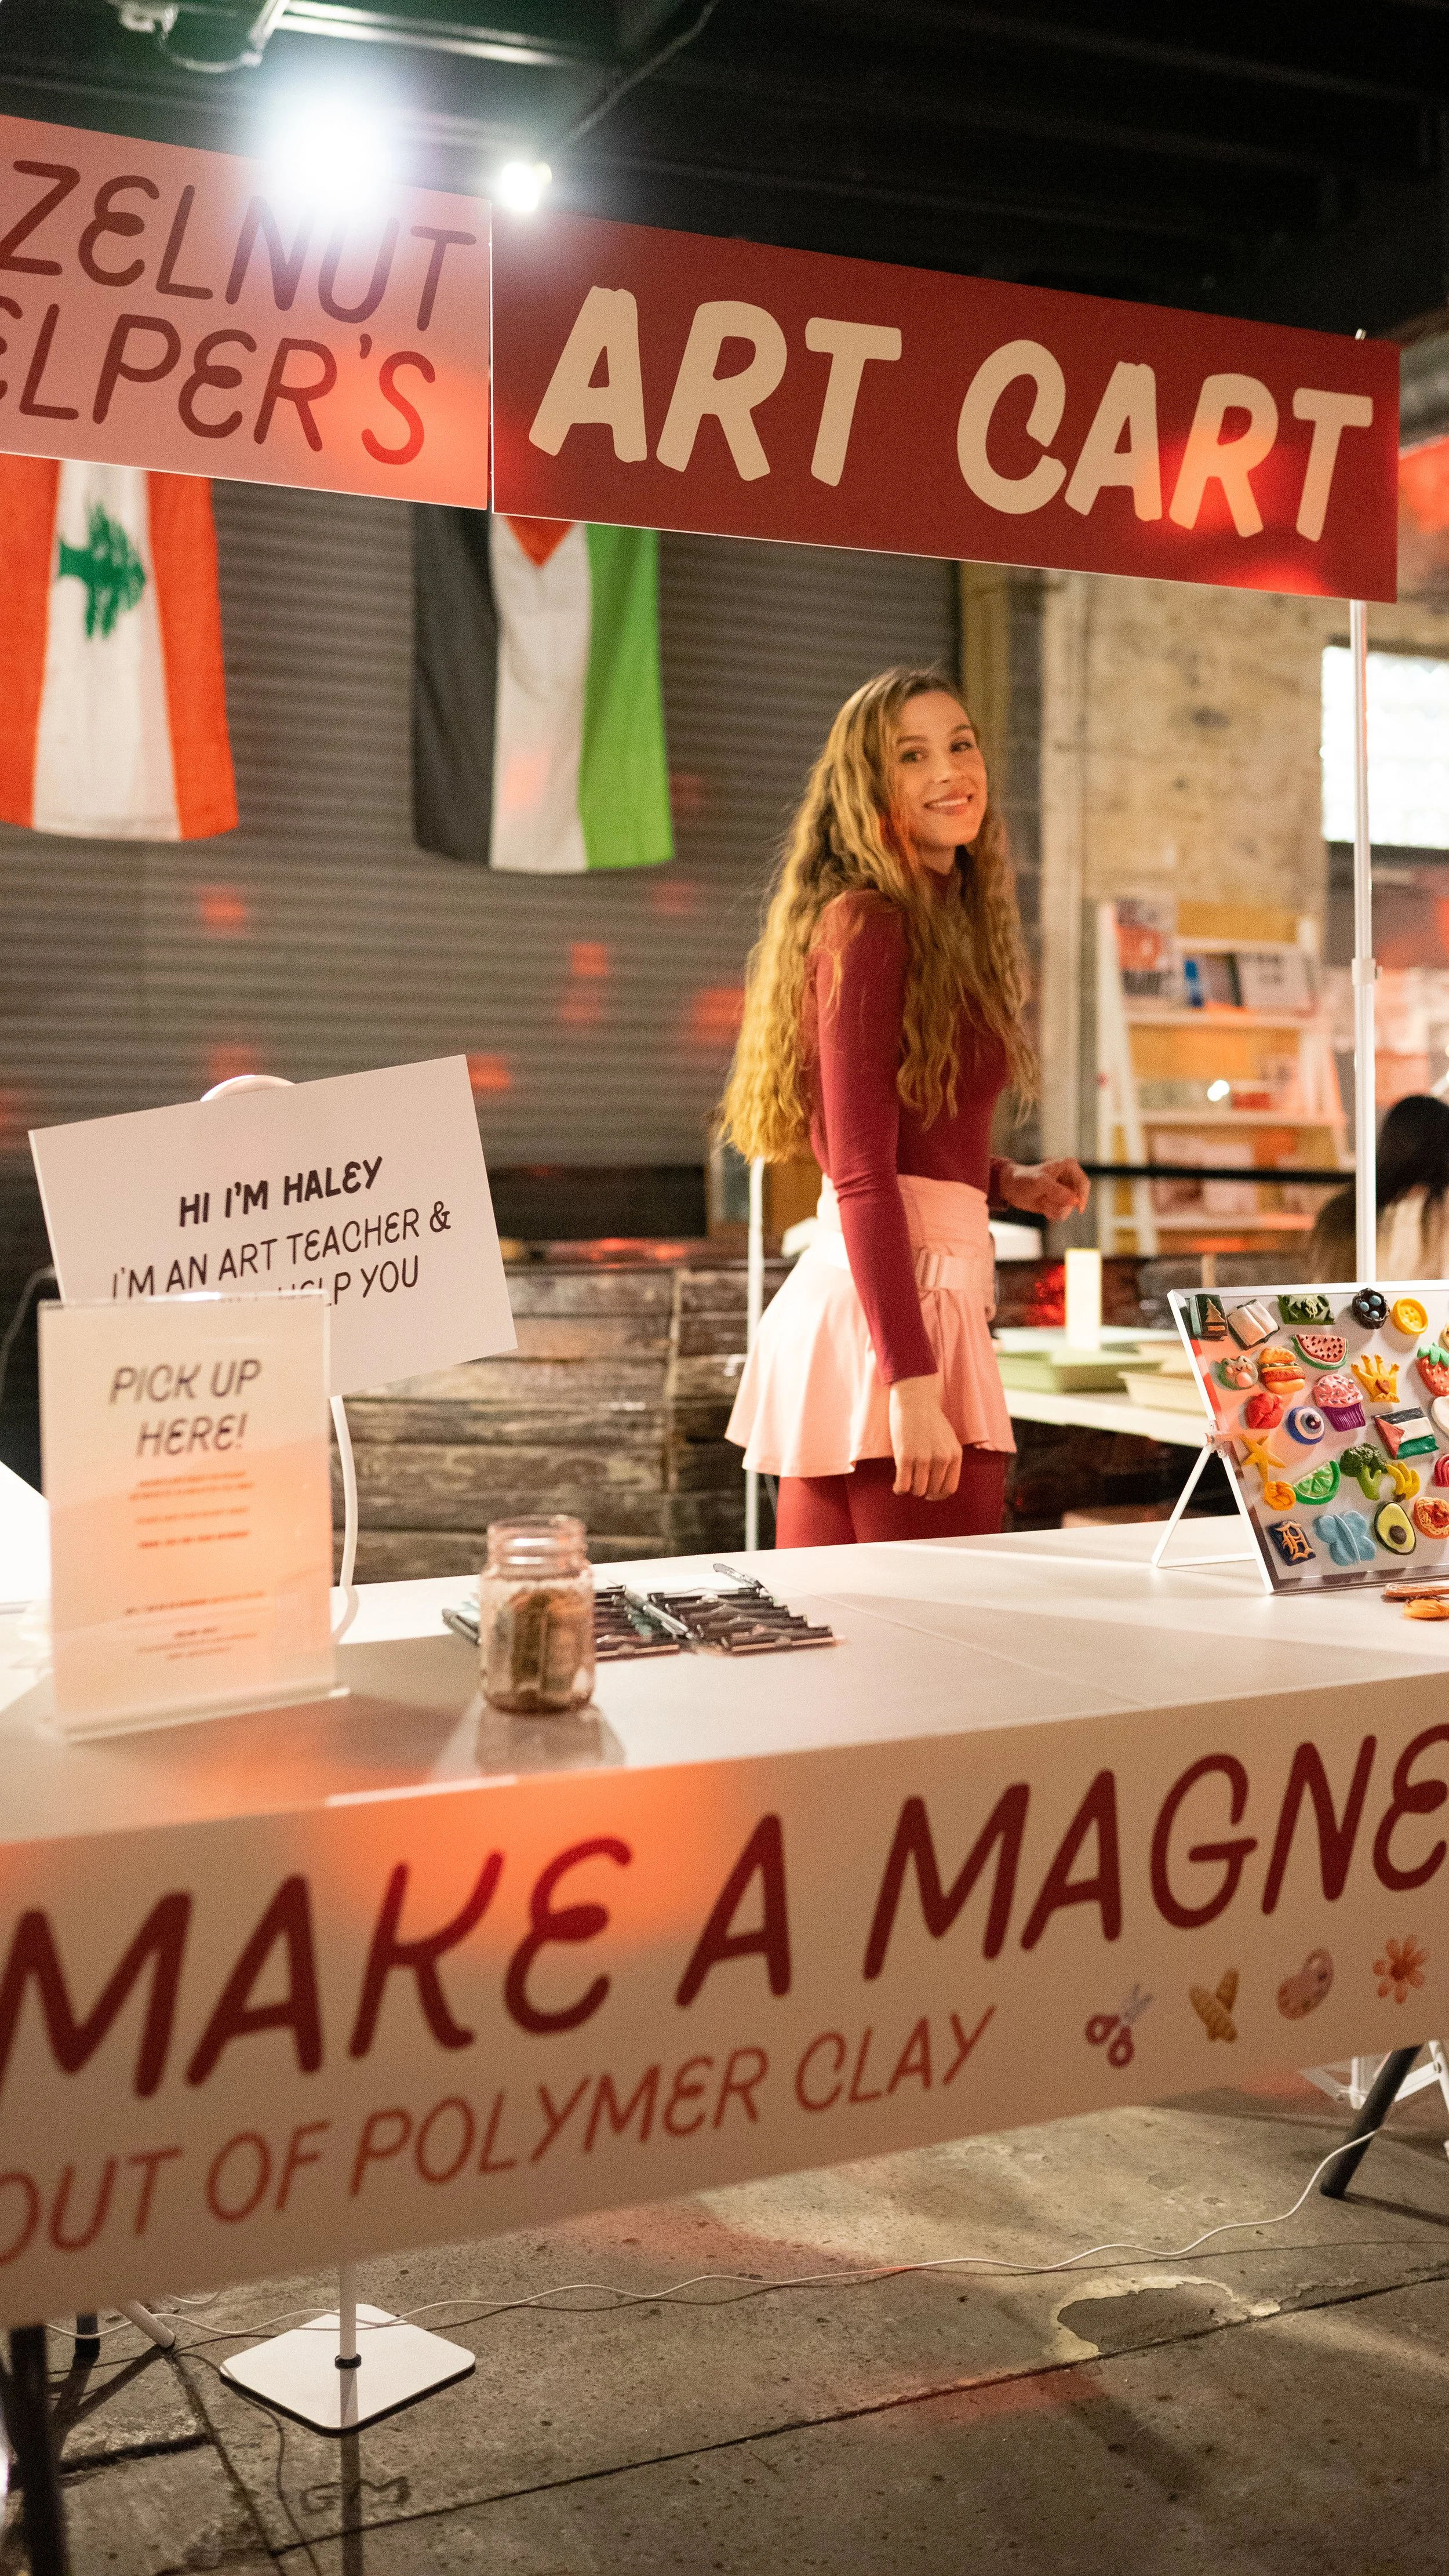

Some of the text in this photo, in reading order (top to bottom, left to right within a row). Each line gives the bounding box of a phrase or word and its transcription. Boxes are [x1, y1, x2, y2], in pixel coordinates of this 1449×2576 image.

[0, 295, 435, 465] LPER'S
[529, 285, 1373, 542] ART CART
[179, 1156, 383, 1227] HI I'M HALEY
[112, 1201, 452, 1299] I'M AN ART TEACHER &
[361, 1255, 418, 1298] YOU
[108, 1358, 262, 1404] PICK UP
[136, 1412, 248, 1458] HERE!
[0, 1723, 1449, 2101] MAKE A MAGNE
[205, 2120, 330, 2224] OF
[347, 2045, 770, 2199] POLYMER
[794, 2004, 997, 2112] CLAY
